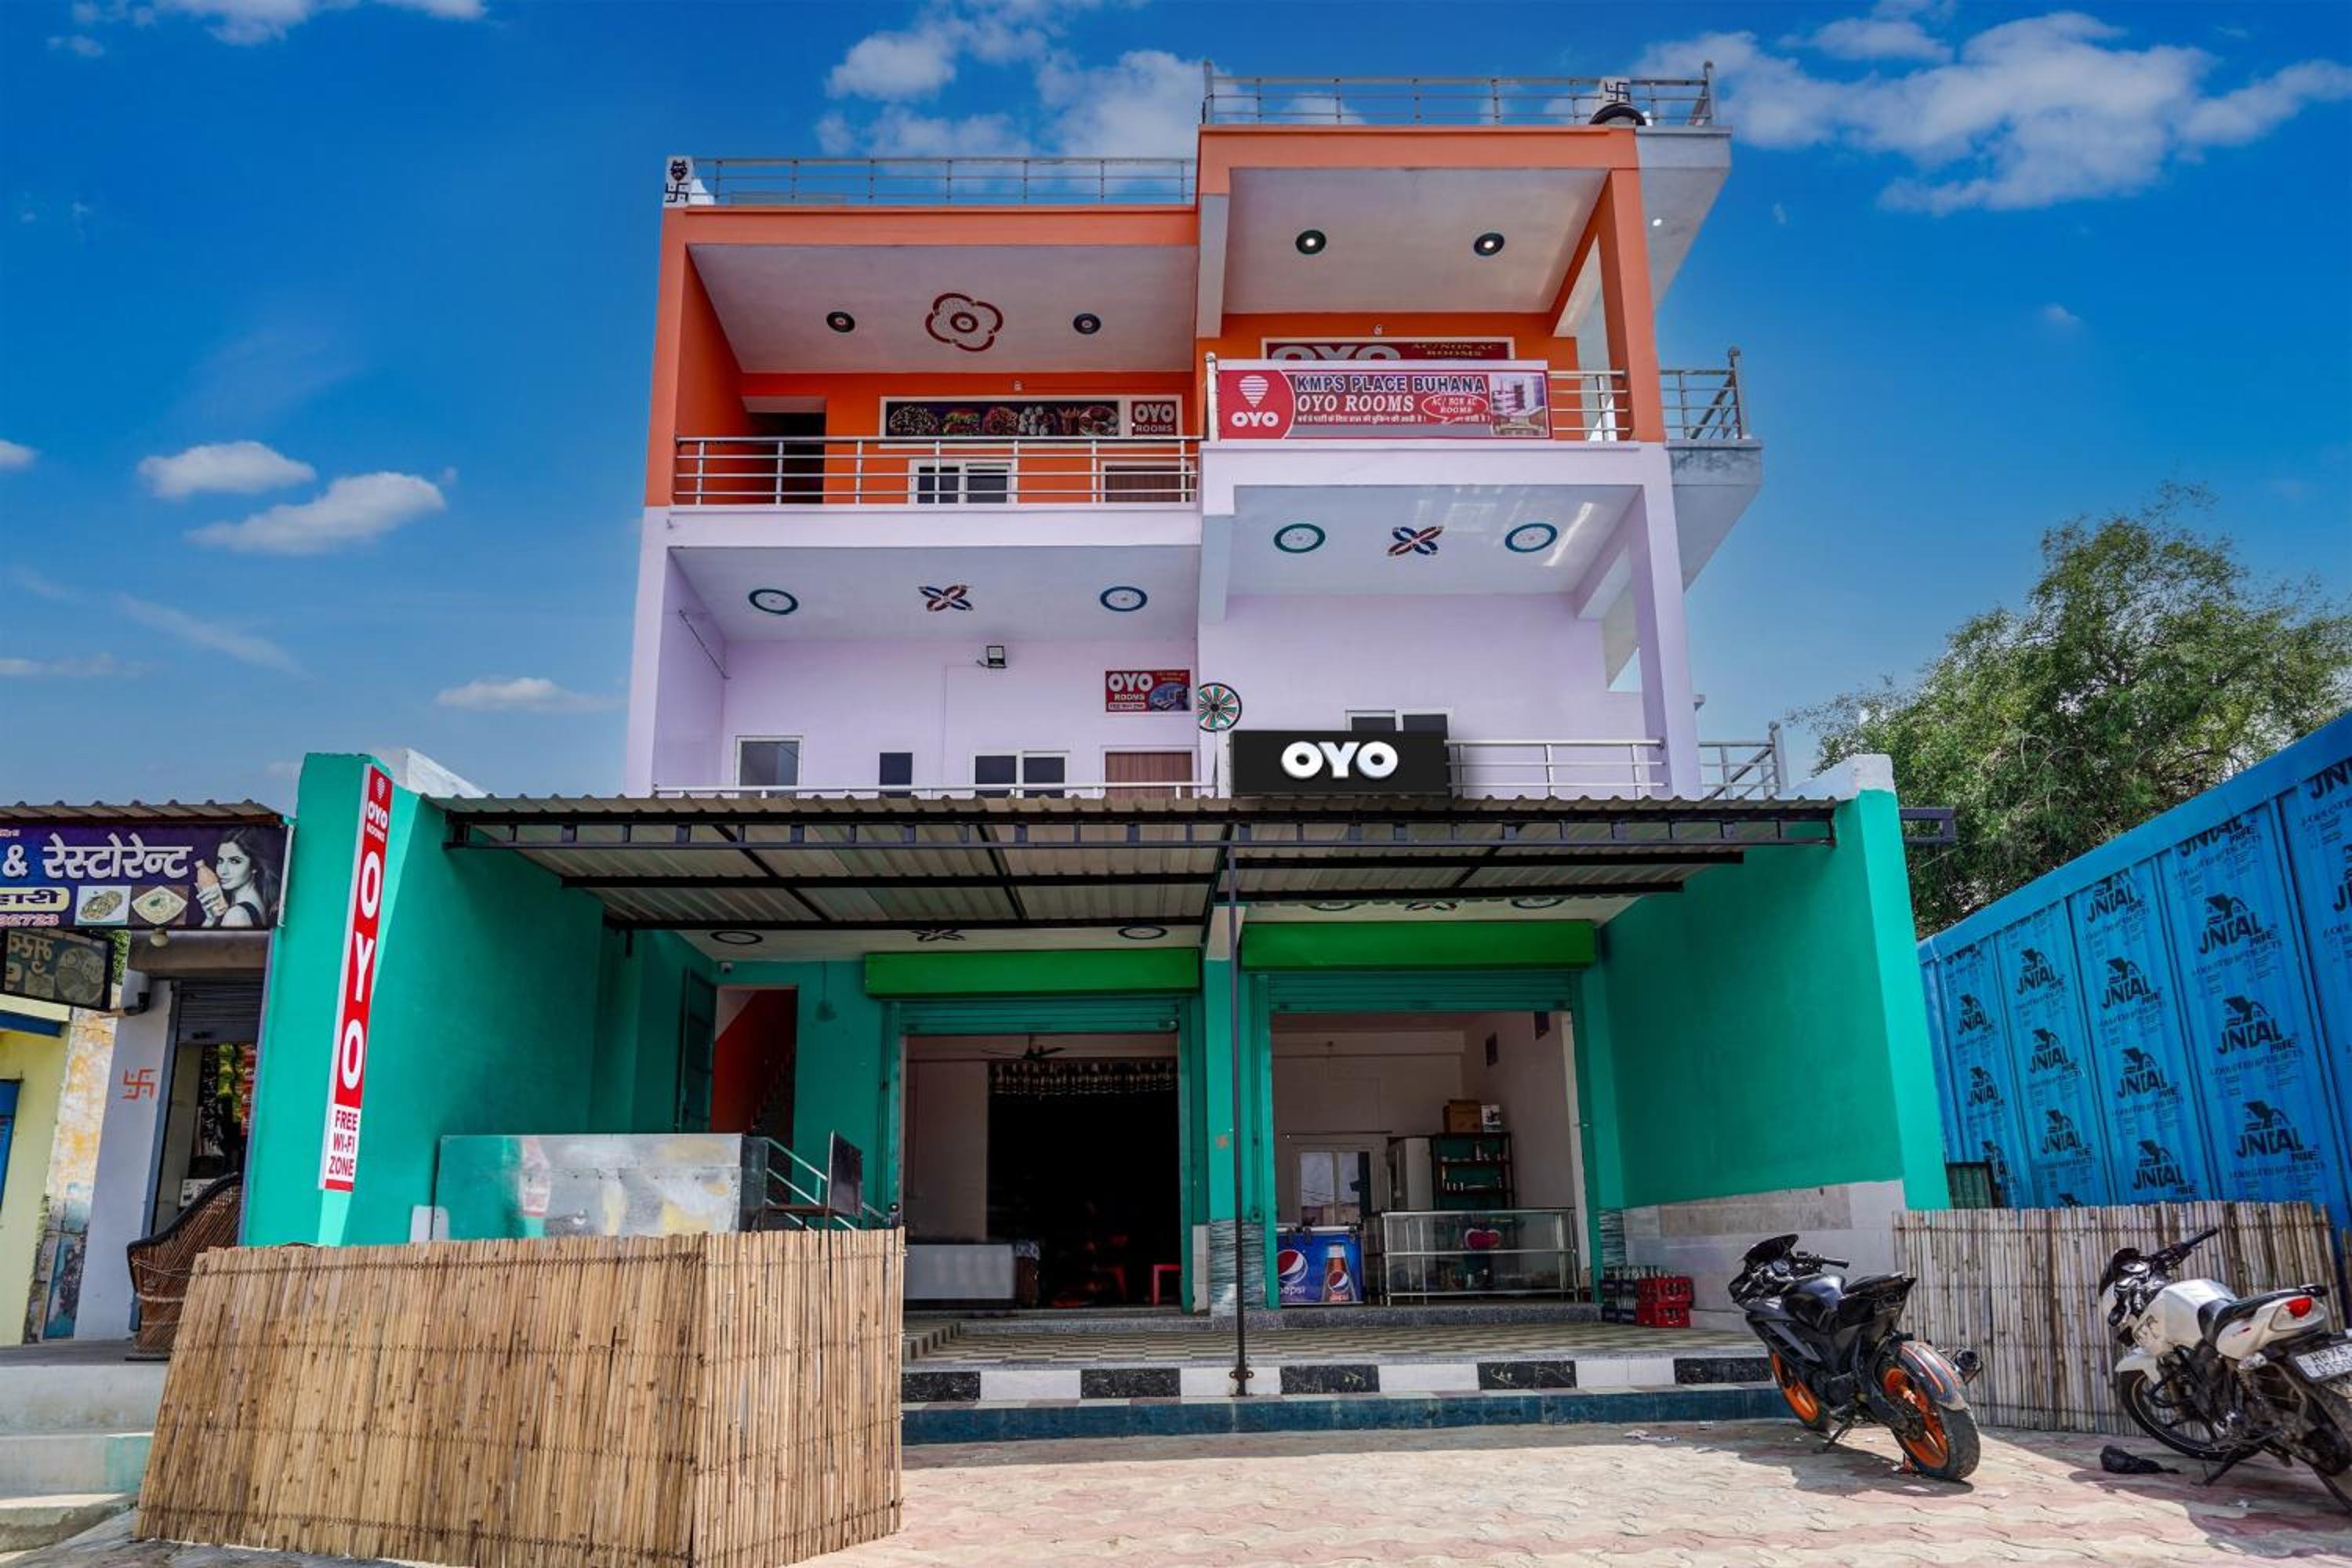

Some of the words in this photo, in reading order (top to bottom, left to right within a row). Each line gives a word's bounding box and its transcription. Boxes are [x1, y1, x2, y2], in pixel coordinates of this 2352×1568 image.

[1296, 376, 1345, 392] KMPS
[1351, 376, 1406, 392] PLACE
[1412, 376, 1486, 393] BUHANA
[1134, 403, 1174, 423] OYO
[1297, 394, 1338, 412] OYO
[1345, 394, 1414, 412] ROOMS
[1135, 424, 1174, 433] ROOMS
[1231, 411, 1279, 427] OYO
[1108, 673, 1154, 692] OYO
[1113, 692, 1145, 701] ROOMS
[1280, 740, 1399, 779] OYO
[367, 800, 389, 829] OYO
[2, 844, 28, 877] &
[42, 831, 194, 880] रेस्टोरेन्ट
[340, 849, 384, 1091] OYO
[335, 1109, 358, 1131] FREE
[333, 1131, 356, 1155] WI-FI
[328, 1155, 355, 1178] ZONE
